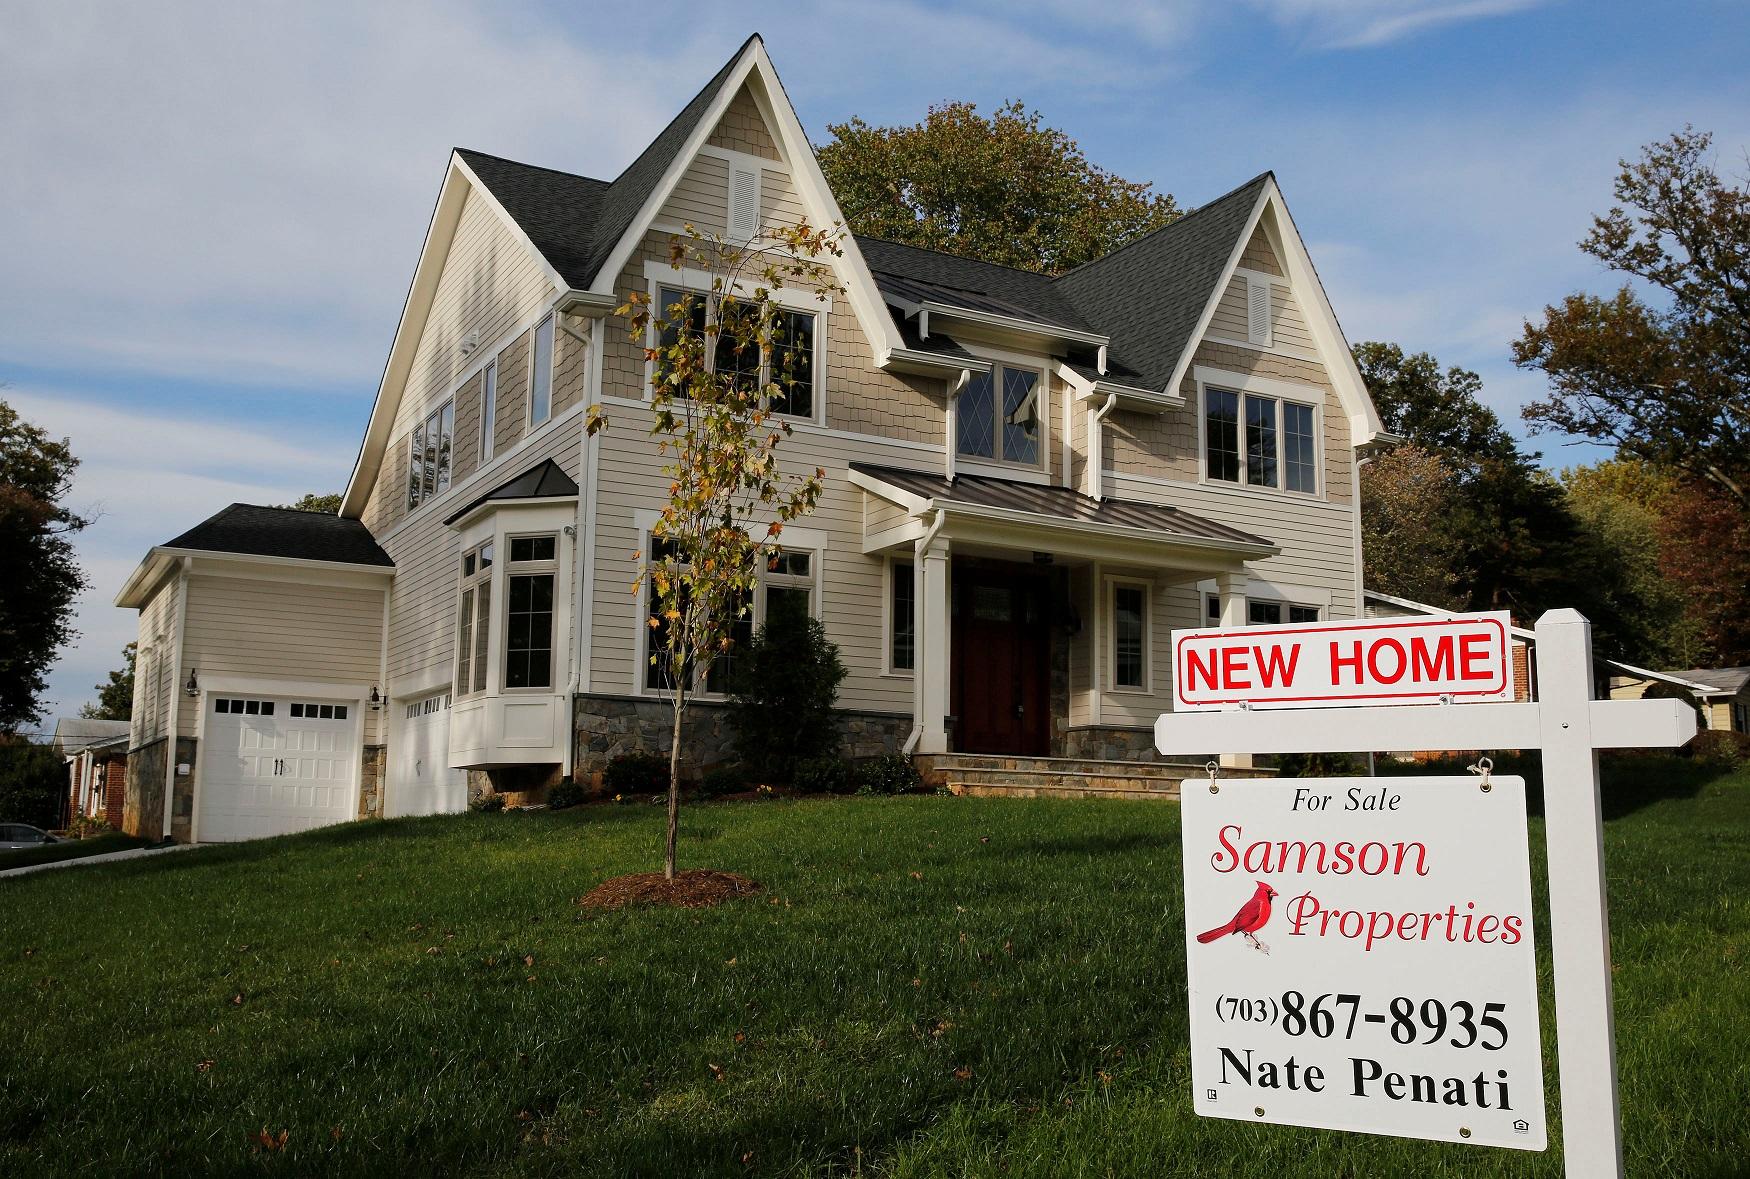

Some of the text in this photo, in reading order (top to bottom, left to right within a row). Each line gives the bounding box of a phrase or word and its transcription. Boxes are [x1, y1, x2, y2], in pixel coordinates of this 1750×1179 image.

[1187, 633, 1494, 691] NEW HOME
[1292, 787, 1401, 812] For Sale
[1210, 825, 1430, 877] Samson
[1286, 891, 1523, 952] Properties
[1217, 1047, 1514, 1111] Nate Penati
